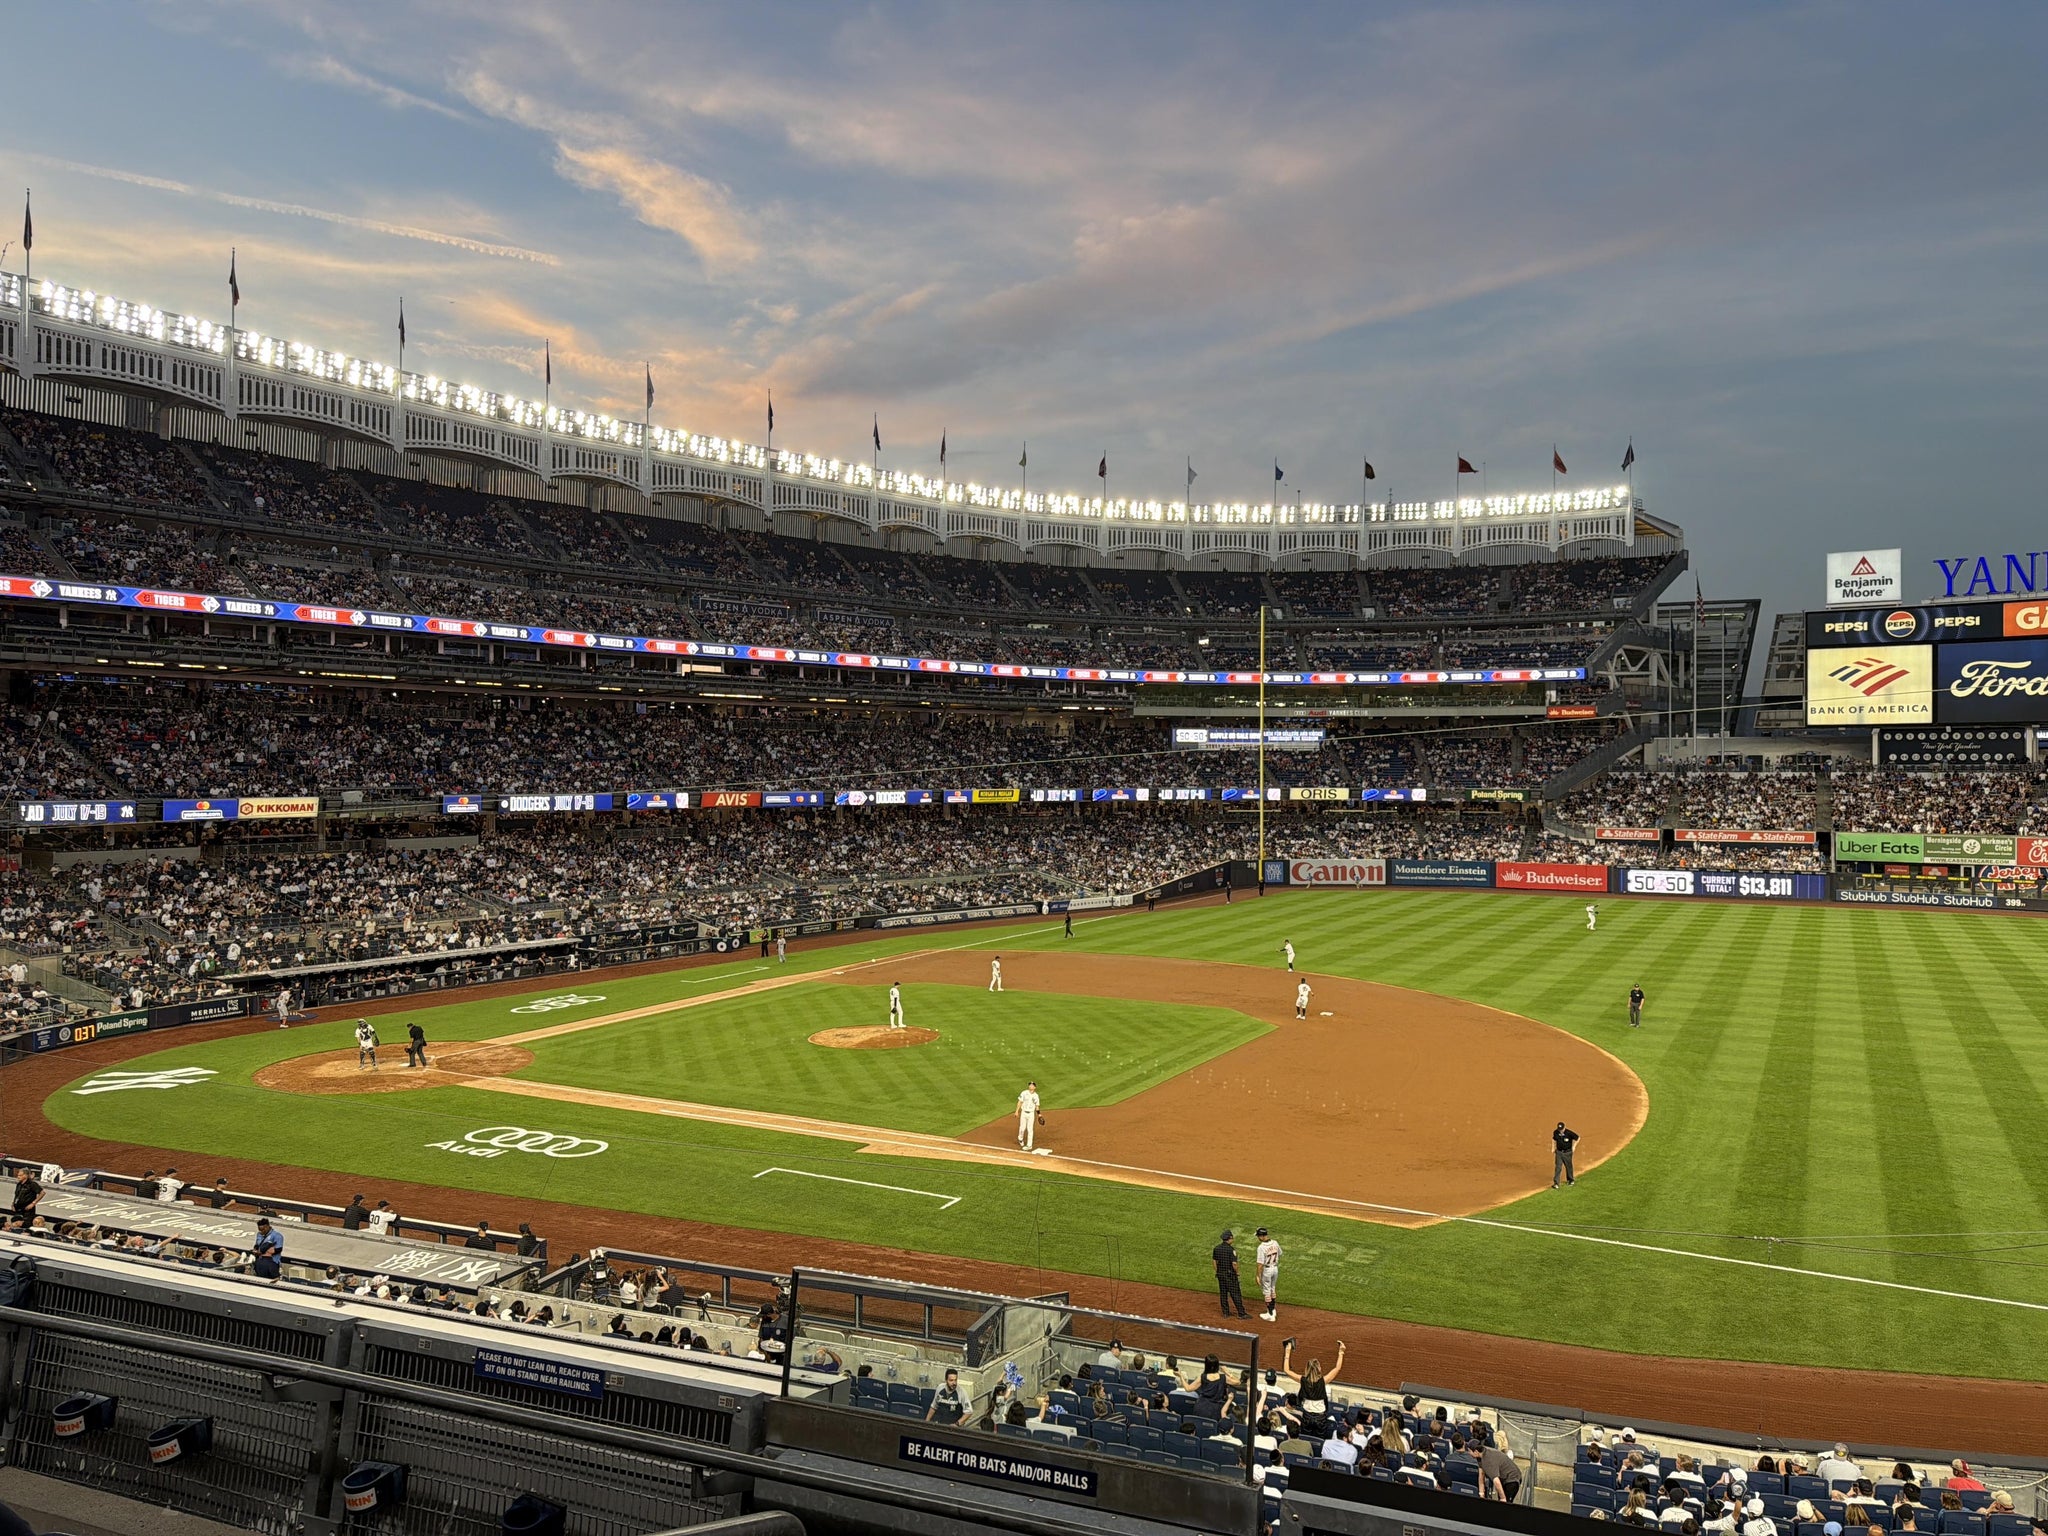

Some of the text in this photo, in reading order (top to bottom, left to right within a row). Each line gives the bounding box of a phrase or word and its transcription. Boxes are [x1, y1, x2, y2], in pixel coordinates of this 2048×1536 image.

[1834, 576, 1893, 589] Benjamin
[58, 585, 102, 599] YANKEES
[1842, 588, 1882, 598] Moore
[154, 594, 185, 606] TIGERS
[225, 601, 261, 614] YANKEES
[705, 602, 783, 616] ASPEN VODKA
[310, 609, 336, 620] TIGERS
[371, 614, 401, 626] YANKEES
[823, 614, 890, 627] ASPEN VODKA
[439, 621, 462, 632] TIGERS
[1825, 622, 1868, 633] PEPSI
[1887, 620, 1914, 628] PEPSI
[1934, 616, 1980, 628] PEPSI
[1849, 706, 1865, 714] OF
[1868, 704, 1928, 713] AMERICA
[1937, 742, 1952, 751] York
[1952, 742, 1981, 751] Yankees
[715, 793, 748, 806] AVIS
[1301, 789, 1337, 798] ORIS
[1471, 790, 1522, 800] Poland Spring
[257, 803, 314, 812] KIKKOMAN
[510, 796, 550, 812] DODGERS
[554, 795, 572, 810] JULY
[52, 804, 78, 821] JULY
[1927, 837, 1961, 845] Morningside
[1840, 841, 1919, 854] Uber Eats
[1291, 862, 1383, 882] Canon
[1396, 865, 1487, 875] Montefiore Einstein
[1988, 866, 2039, 880] Jersey
[1634, 876, 1686, 891] 50 50
[1701, 875, 1736, 885] CURRENT
[1739, 875, 1792, 897] $13,811
[1706, 884, 1732, 893] TOTAL:
[1840, 892, 1992, 907] StubHub StubHub StubHub
[191, 1007, 226, 1017] MERRILL
[97, 1016, 148, 1033] Poland Spring
[74, 1025, 95, 1042] 037
[424, 1140, 509, 1158] Audi
[36, 1194, 254, 1238] New York Yankees
[369, 1214, 380, 1225] 30
[400, 1250, 446, 1259] NEW
[1267, 1252, 1277, 1264] 77
[374, 1260, 415, 1272] LIFE
[391, 1254, 438, 1268] YORK
[478, 1351, 601, 1382] PLEASE DO NOT LEAN ON, REACH OVER,
[484, 1364, 592, 1392] SIT ON OR STAND NEAR RAILINGS.
[907, 1442, 1088, 1490] BE ALERT FOR BATS AND/OR BALLS
